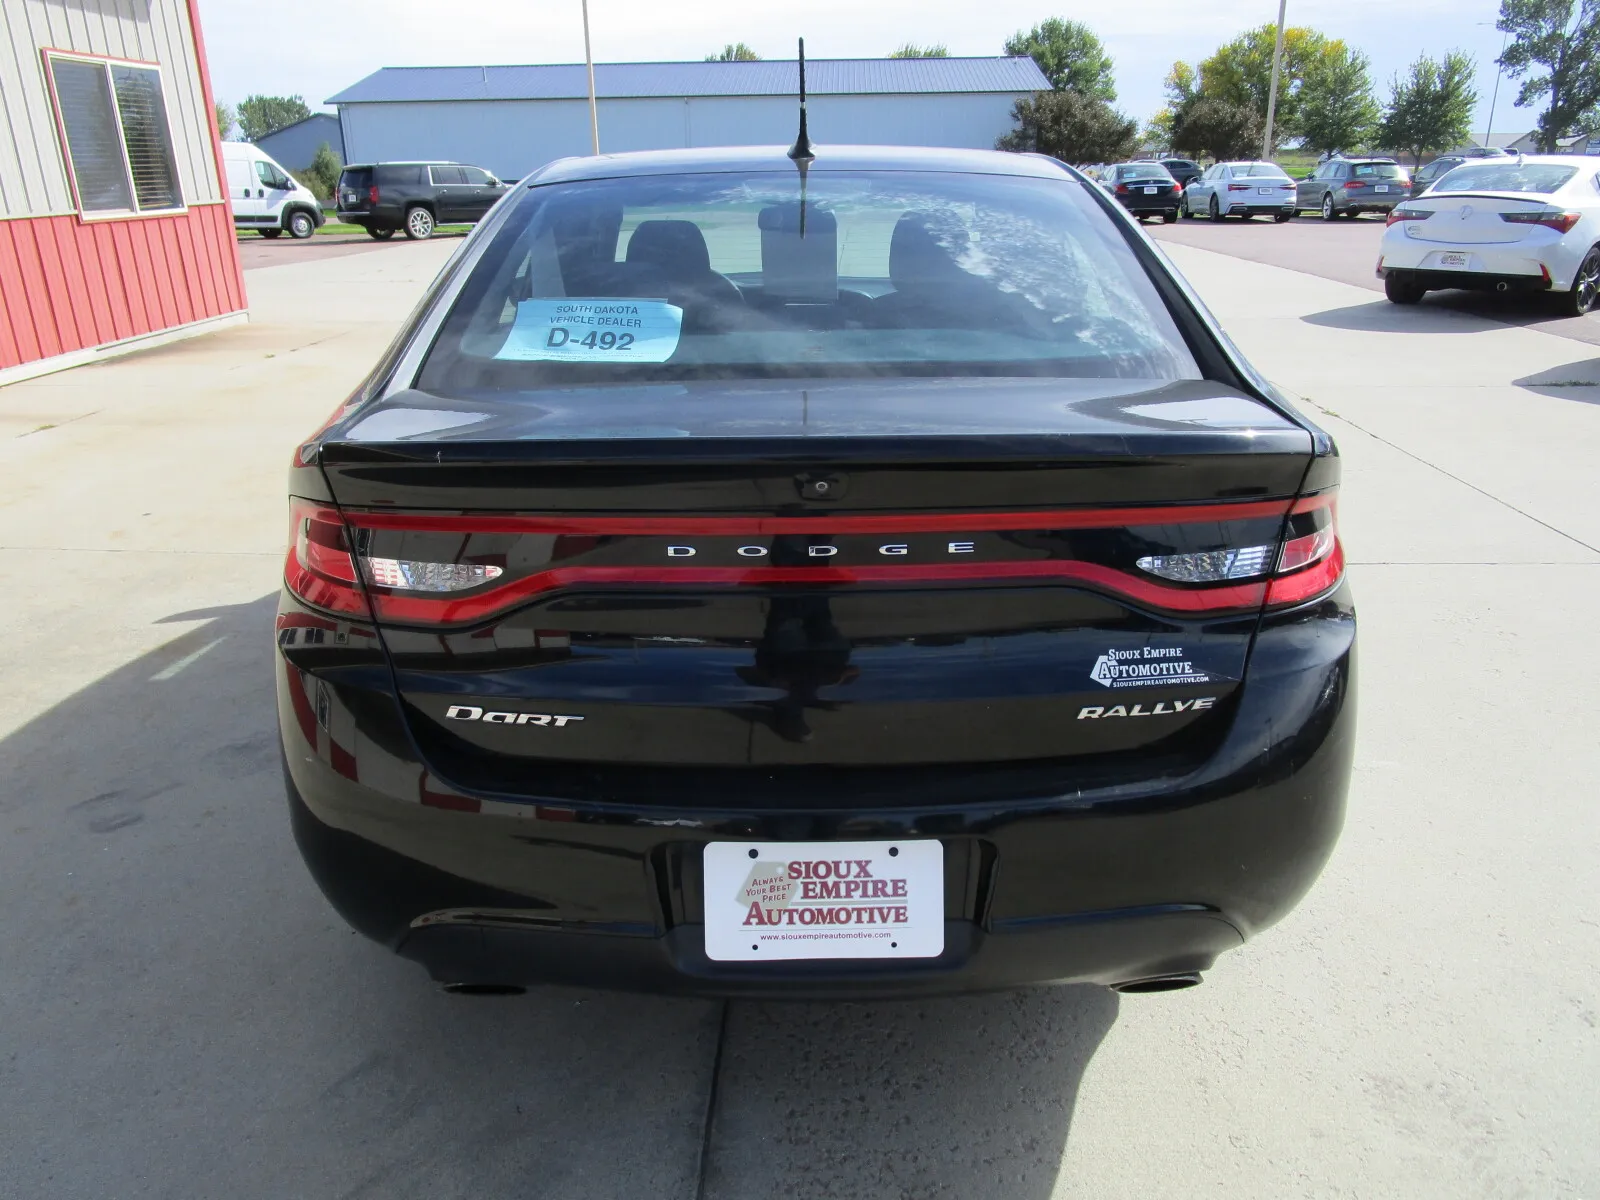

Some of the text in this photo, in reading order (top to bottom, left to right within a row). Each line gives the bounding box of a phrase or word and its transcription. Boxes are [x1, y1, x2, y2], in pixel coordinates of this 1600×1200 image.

[594, 306, 639, 315] DAKOTA
[550, 316, 642, 328] VEHICLE DEALER
[546, 327, 635, 350] D-492
[667, 541, 975, 557] DODGE
[1108, 647, 1183, 660] SIOUX EMPIRE
[1099, 661, 1193, 679] AUTOMOTIVE
[1076, 696, 1217, 720] RALLYE
[788, 860, 873, 880] SIOUX
[800, 879, 908, 900] EMPIRE
[742, 901, 908, 926] AUTOMOTIVE
[760, 931, 892, 941] www.siouxempireautomotive.com
